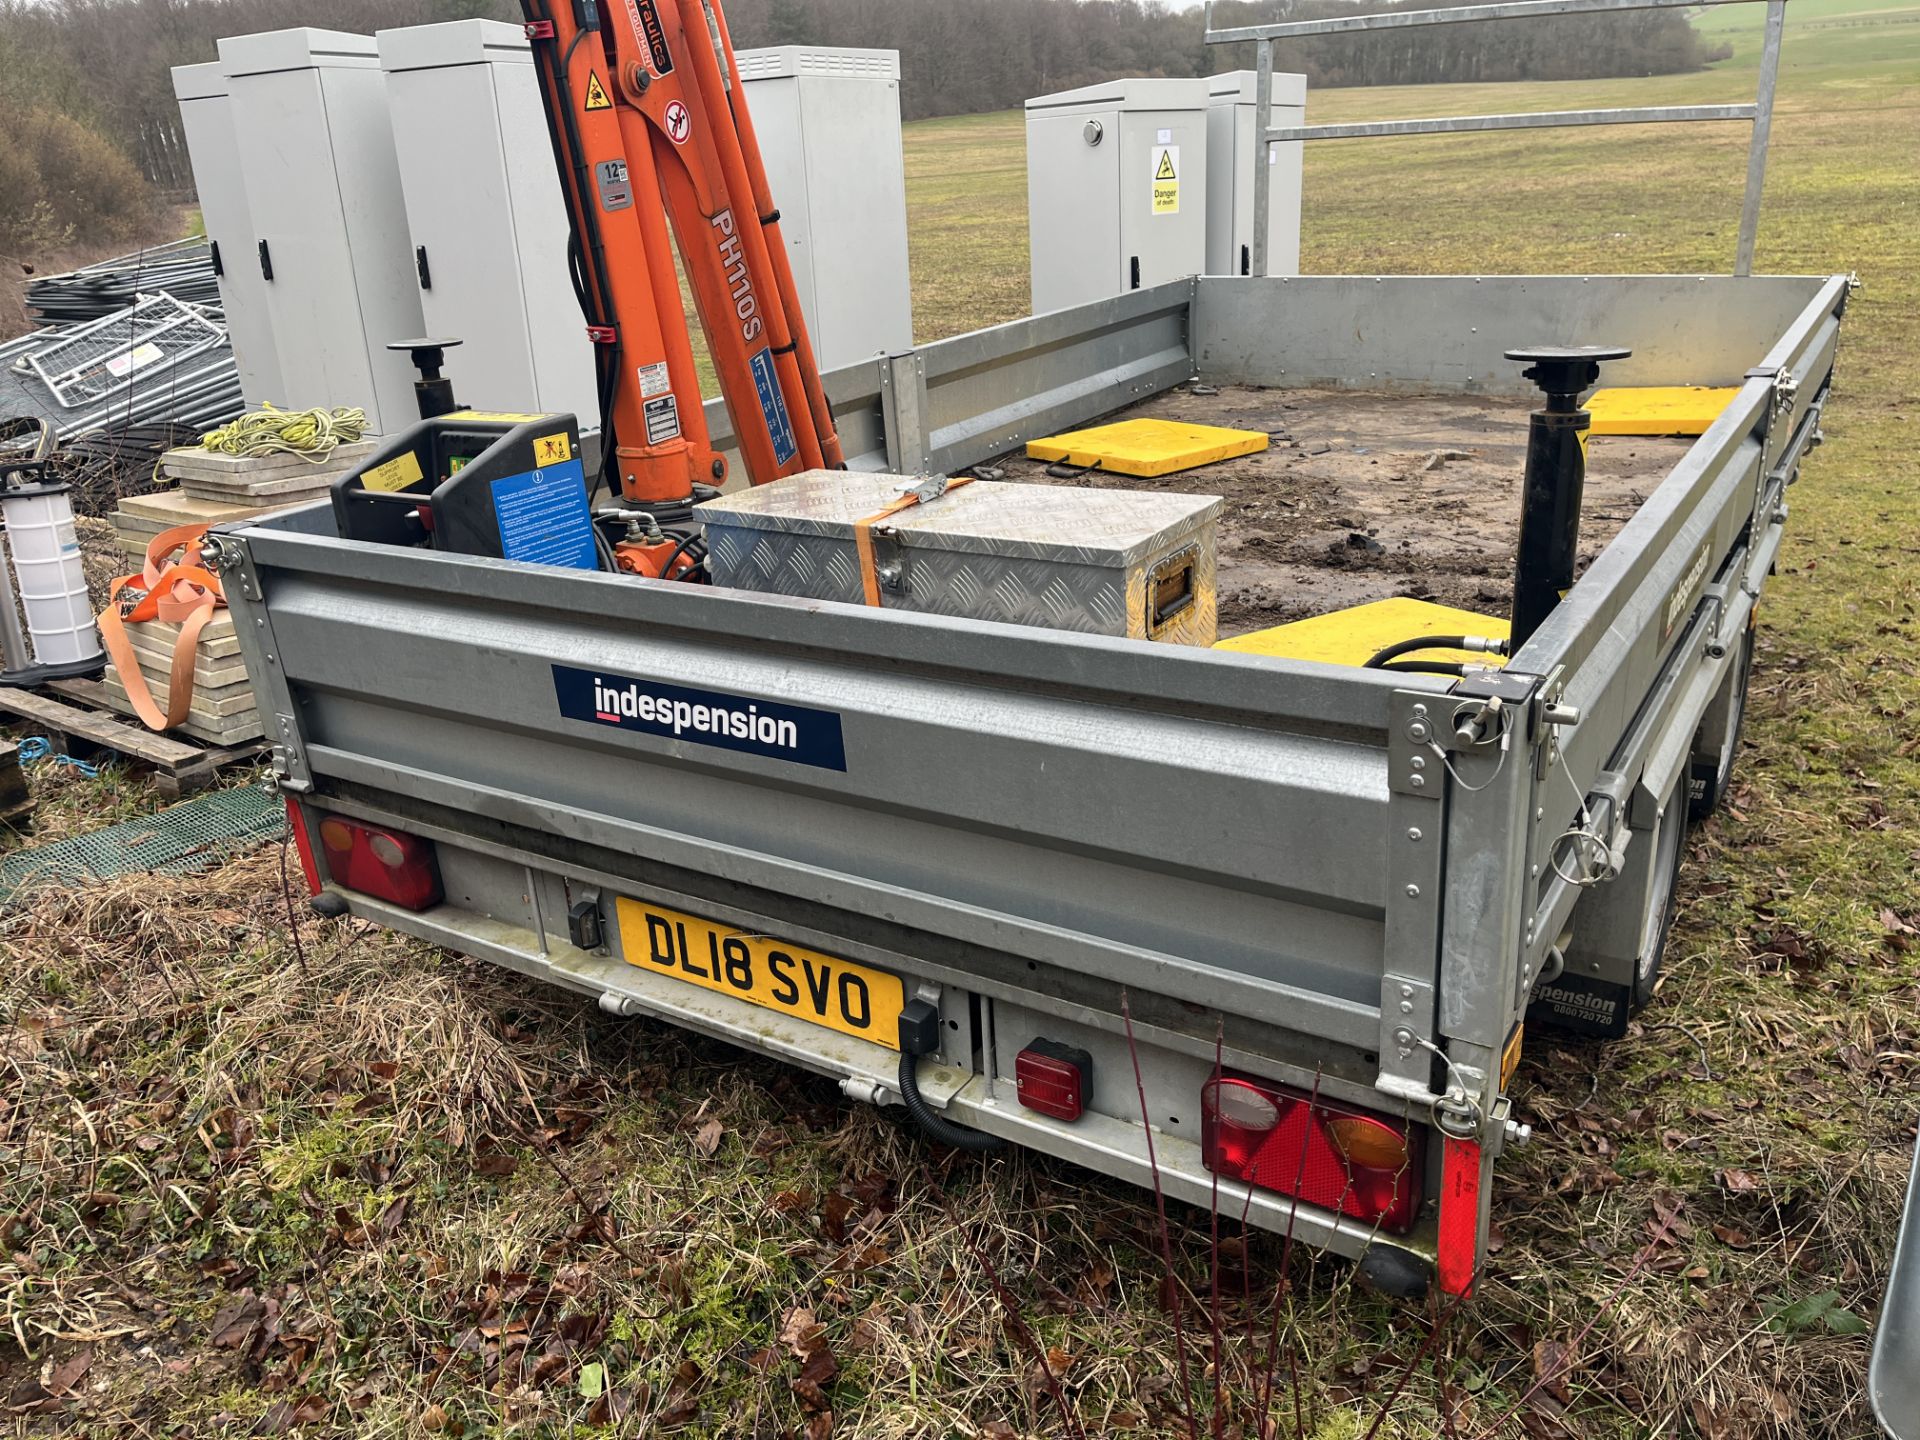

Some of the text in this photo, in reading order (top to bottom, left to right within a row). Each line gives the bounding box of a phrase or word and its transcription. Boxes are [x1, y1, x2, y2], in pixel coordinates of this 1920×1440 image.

[639, 0, 666, 67] raulics
[605, 163, 619, 179] 12
[1154, 189, 1177, 199] Danger
[711, 209, 762, 342] PH110S
[594, 677, 797, 748] indespension
[645, 912, 871, 1029] DL18 SVO
[1530, 984, 1616, 1012] spension
[1553, 1004, 1613, 1025] 0800 720 720
